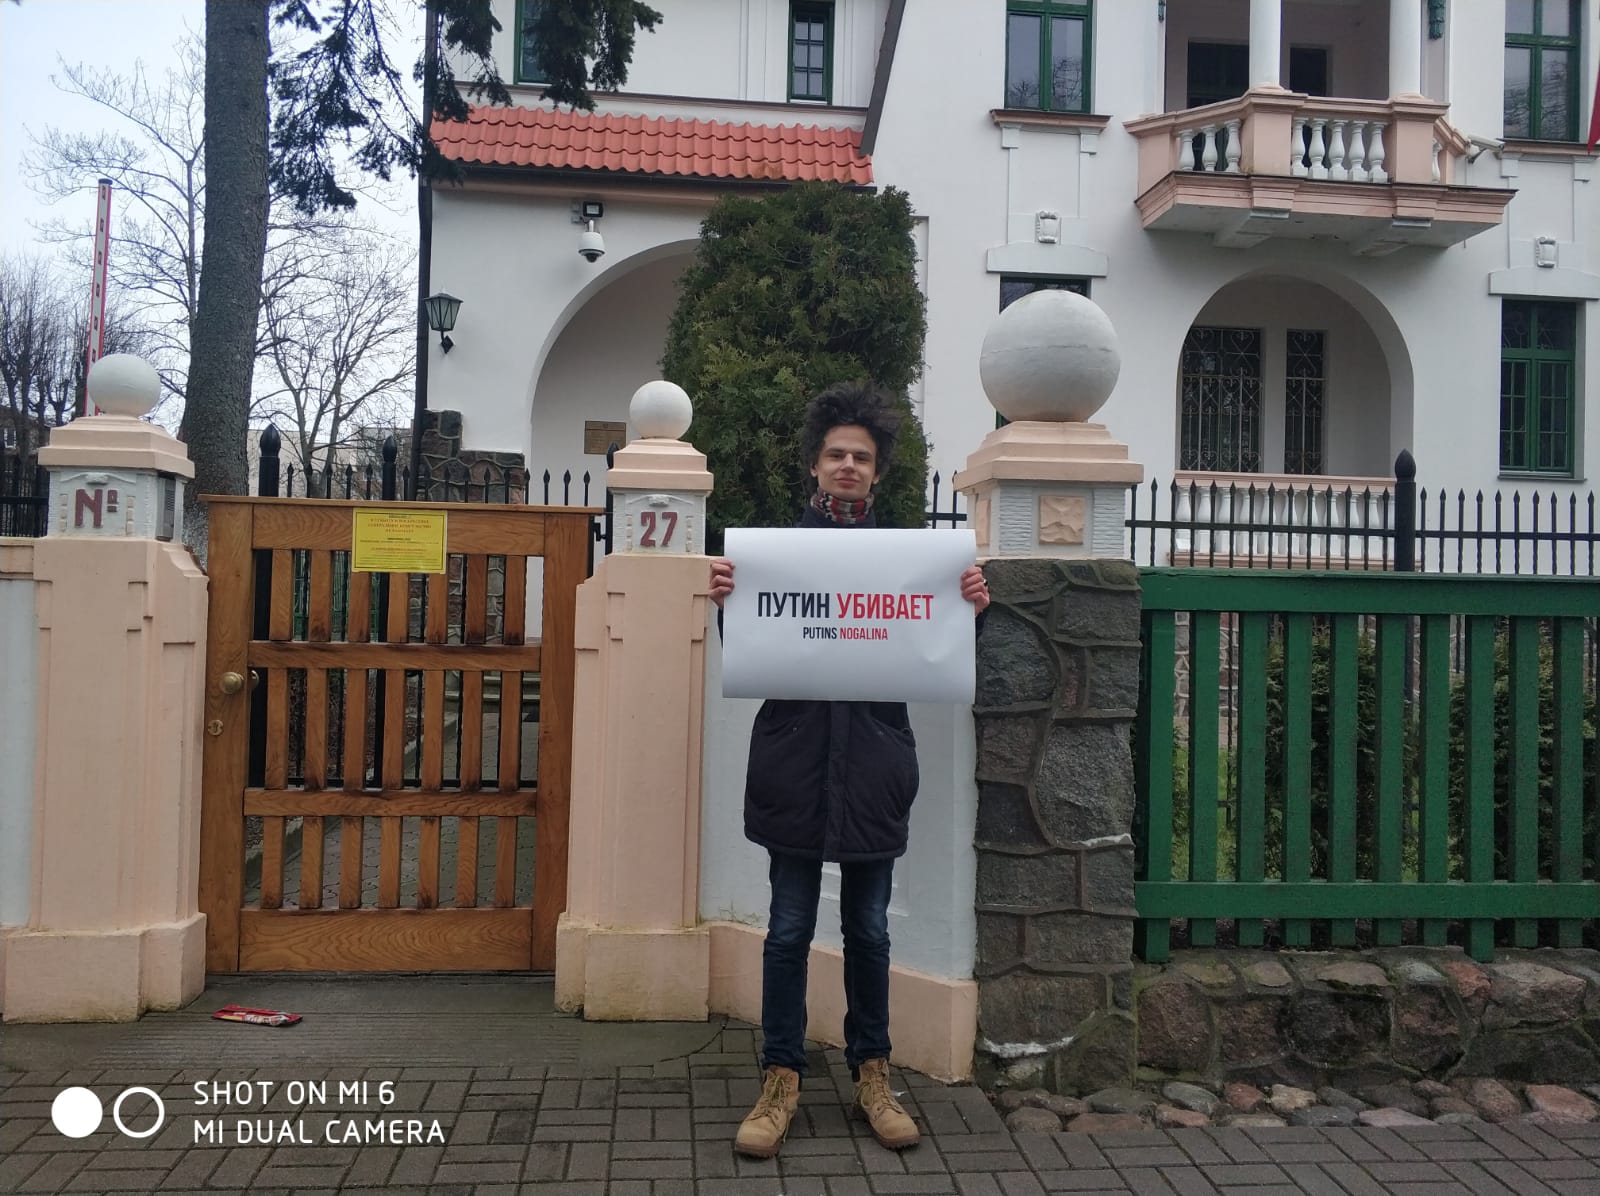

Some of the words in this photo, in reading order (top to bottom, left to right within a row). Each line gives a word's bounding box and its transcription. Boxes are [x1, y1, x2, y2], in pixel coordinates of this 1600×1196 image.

[640, 511, 678, 547] 27
[757, 591, 830, 619] ПУТИН
[836, 593, 935, 620] УБИВАЕТ
[802, 626, 838, 640] PUTINS
[839, 627, 889, 641] NOGALINA
